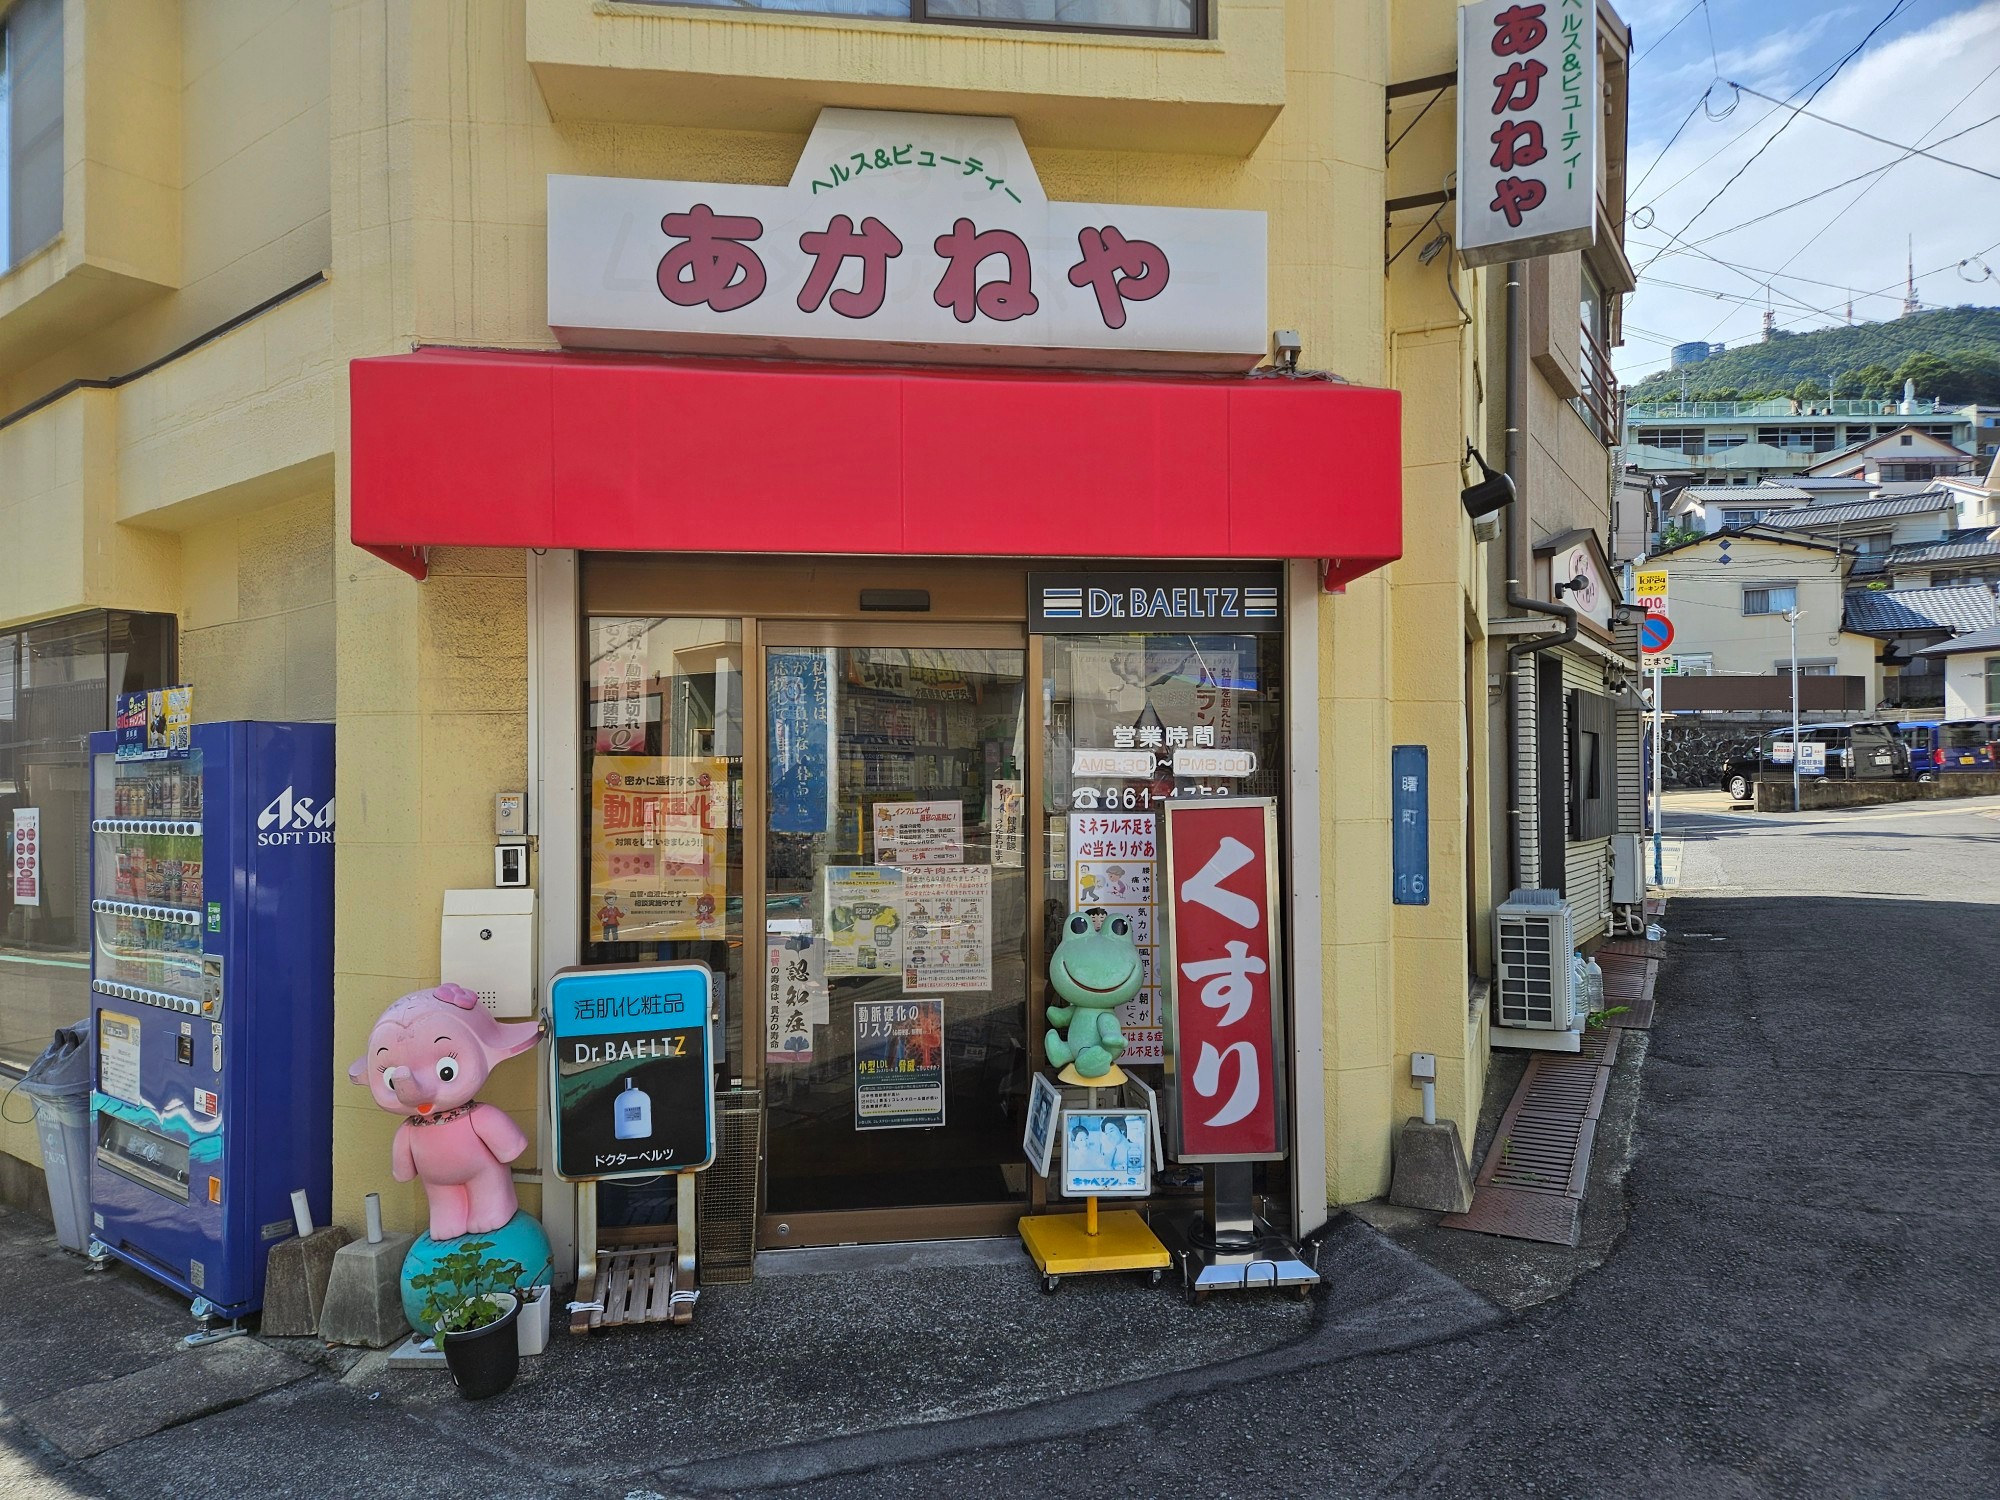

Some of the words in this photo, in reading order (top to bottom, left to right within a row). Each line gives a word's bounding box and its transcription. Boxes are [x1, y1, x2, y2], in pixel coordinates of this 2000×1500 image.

[1490, 4, 1548, 228] あかねや
[811, 144, 1023, 204] ヘルス&ビューティー
[656, 203, 1171, 330] あかねや
[1643, 656, 1671, 666] こまで
[1112, 726, 1215, 748] 営業時間
[624, 775, 696, 786] 密かに進行する
[603, 793, 716, 830] 動脈硬化
[895, 806, 931, 815] インフルエンザ
[1079, 818, 1153, 835] ミネラル不足を
[257, 832, 304, 846] SOFT
[1079, 840, 1155, 857] 心当たりがあ
[1131, 876, 1140, 893] 痛い
[1142, 867, 1151, 902] 腰や膝が
[1398, 873, 1425, 894] 16
[1138, 907, 1148, 942] 気力が
[1180, 836, 1267, 1127] くすり
[574, 993, 685, 1020] 活肌化粧品
[770, 949, 780, 1049] 血管の寿命は、貴方の寿命
[785, 959, 810, 1034] 認知症
[1139, 992, 1149, 1022] 朝が
[858, 1005, 919, 1023] 動脈硬化の
[859, 1021, 893, 1039] リスク
[594, 1149, 674, 1168] ドクターベルツ
